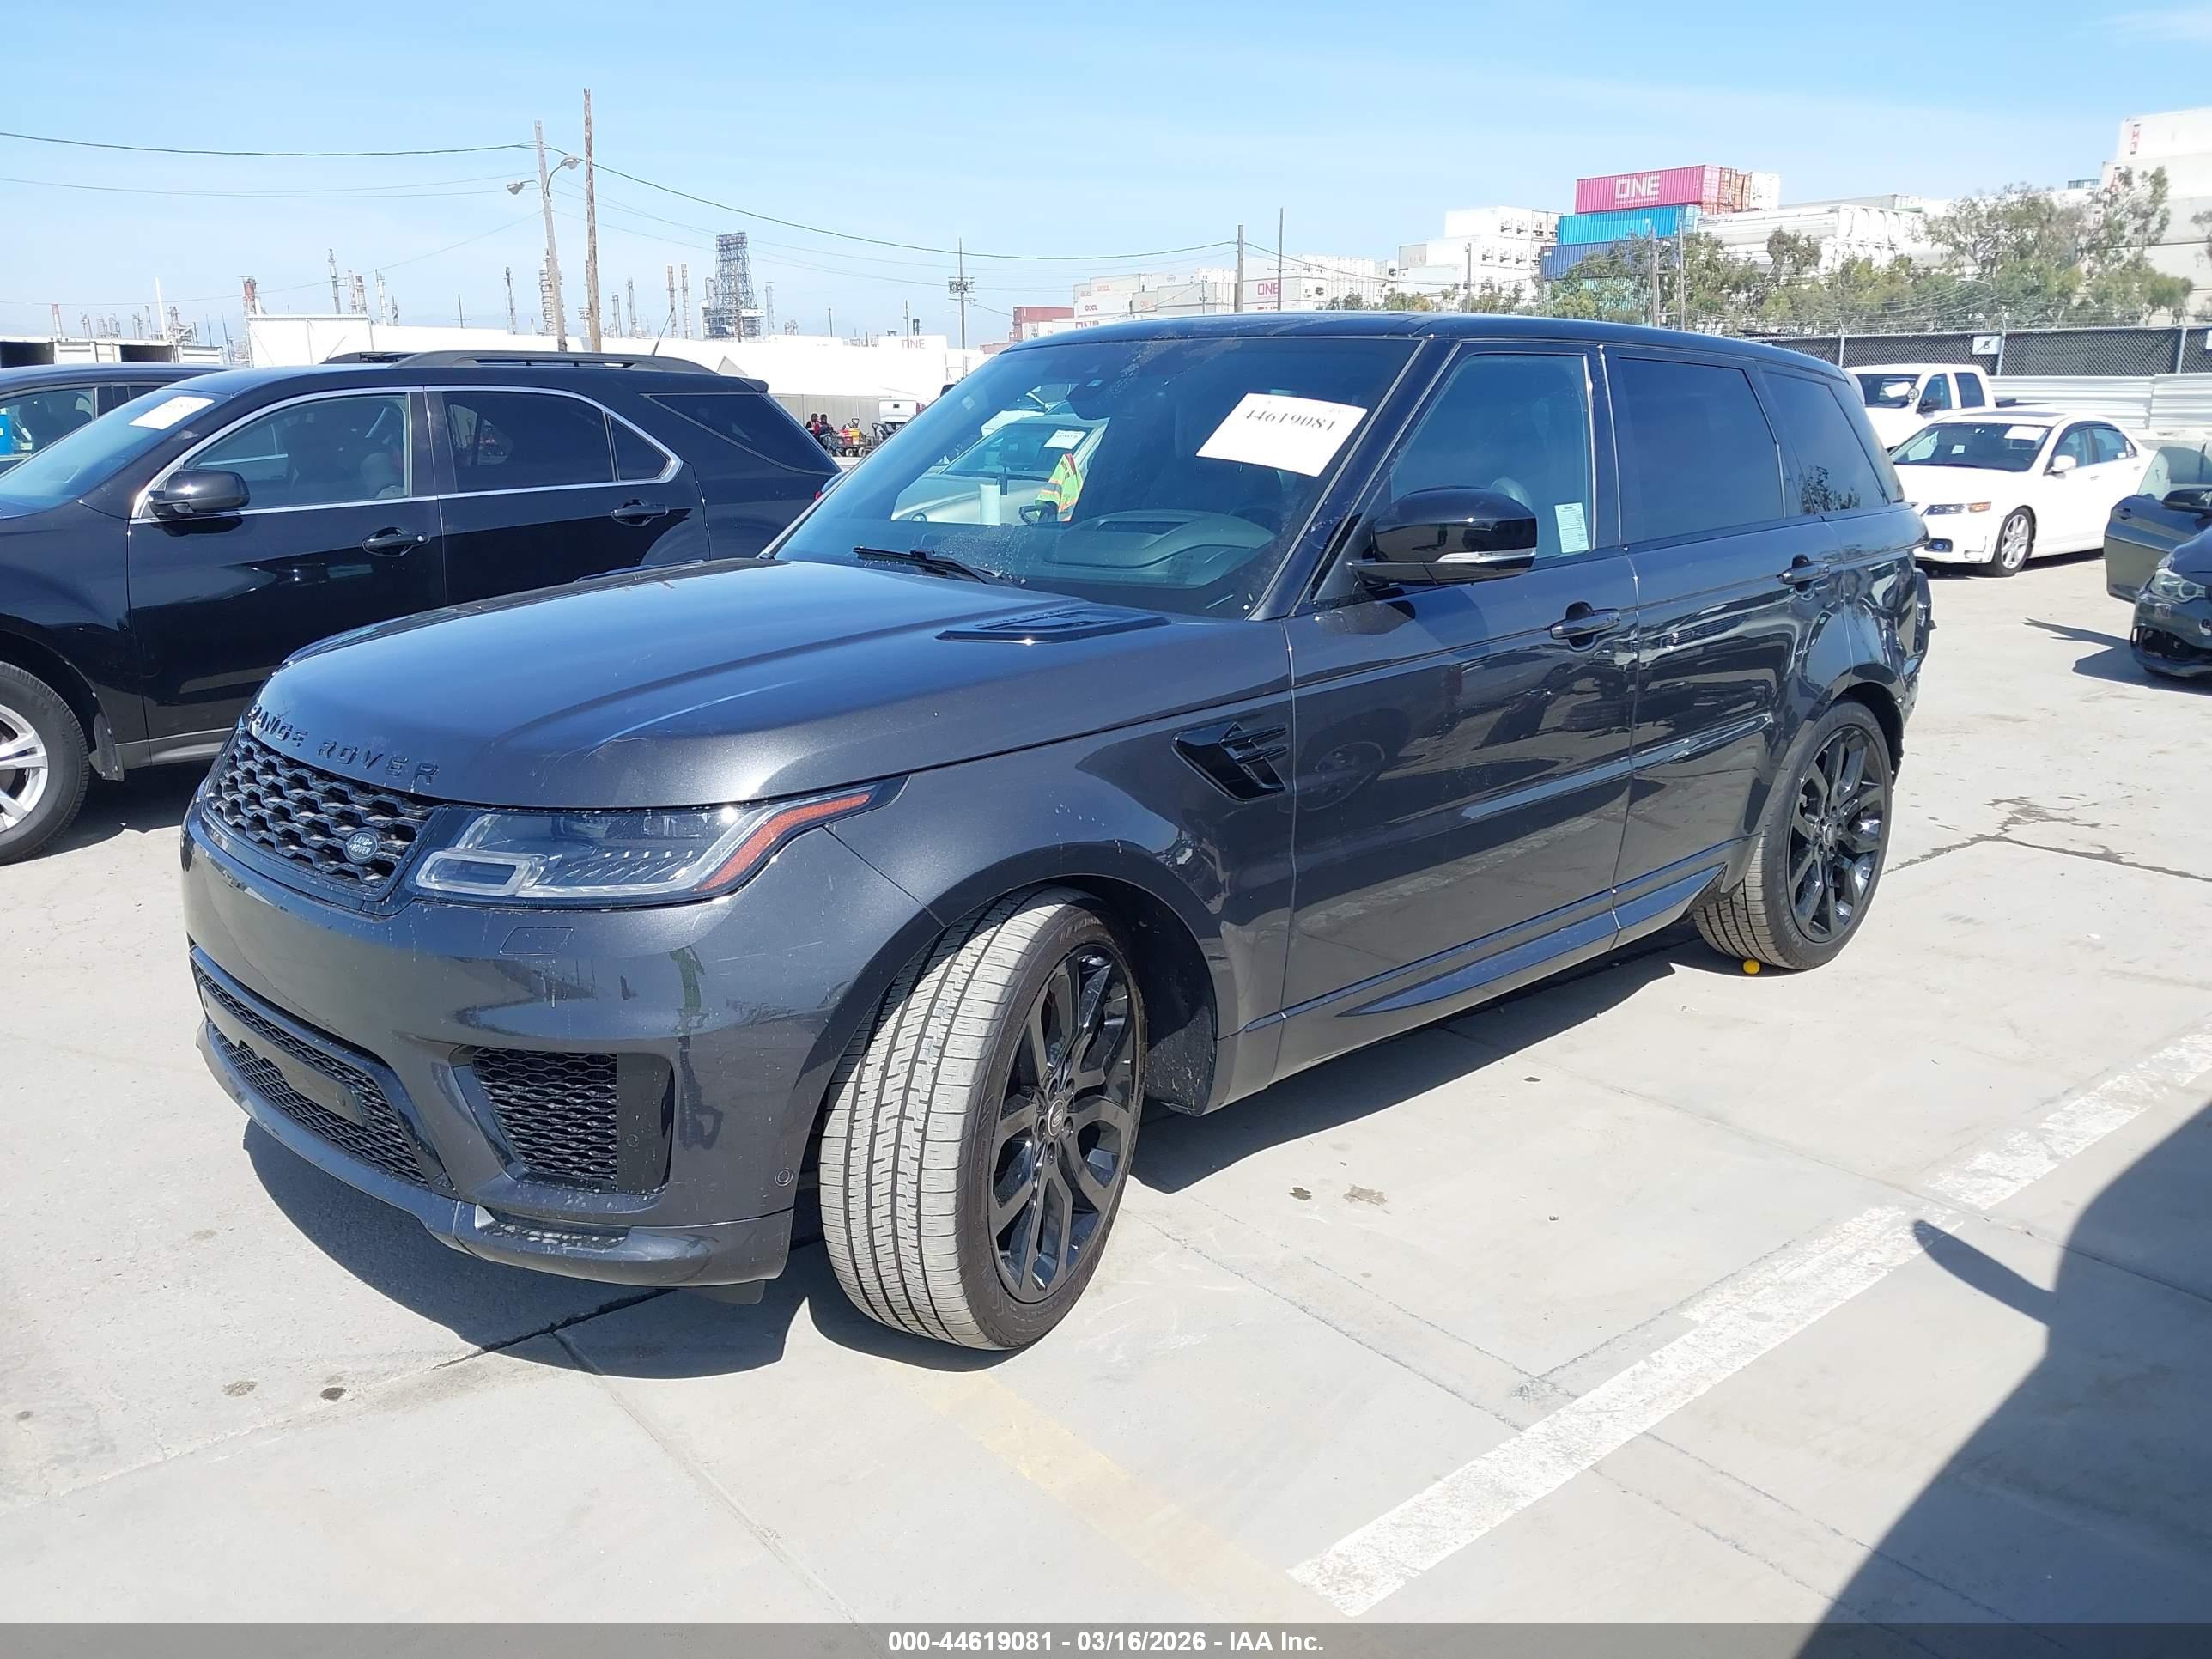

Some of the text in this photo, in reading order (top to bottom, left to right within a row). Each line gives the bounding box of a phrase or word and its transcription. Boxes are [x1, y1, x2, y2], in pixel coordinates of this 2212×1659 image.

[1615, 174, 1661, 199] ONE
[1257, 283, 1279, 295] ONE
[1243, 409, 1335, 431] 44619081
[247, 702, 440, 788] RANGE ROVER
[351, 843, 371, 855] ROVER
